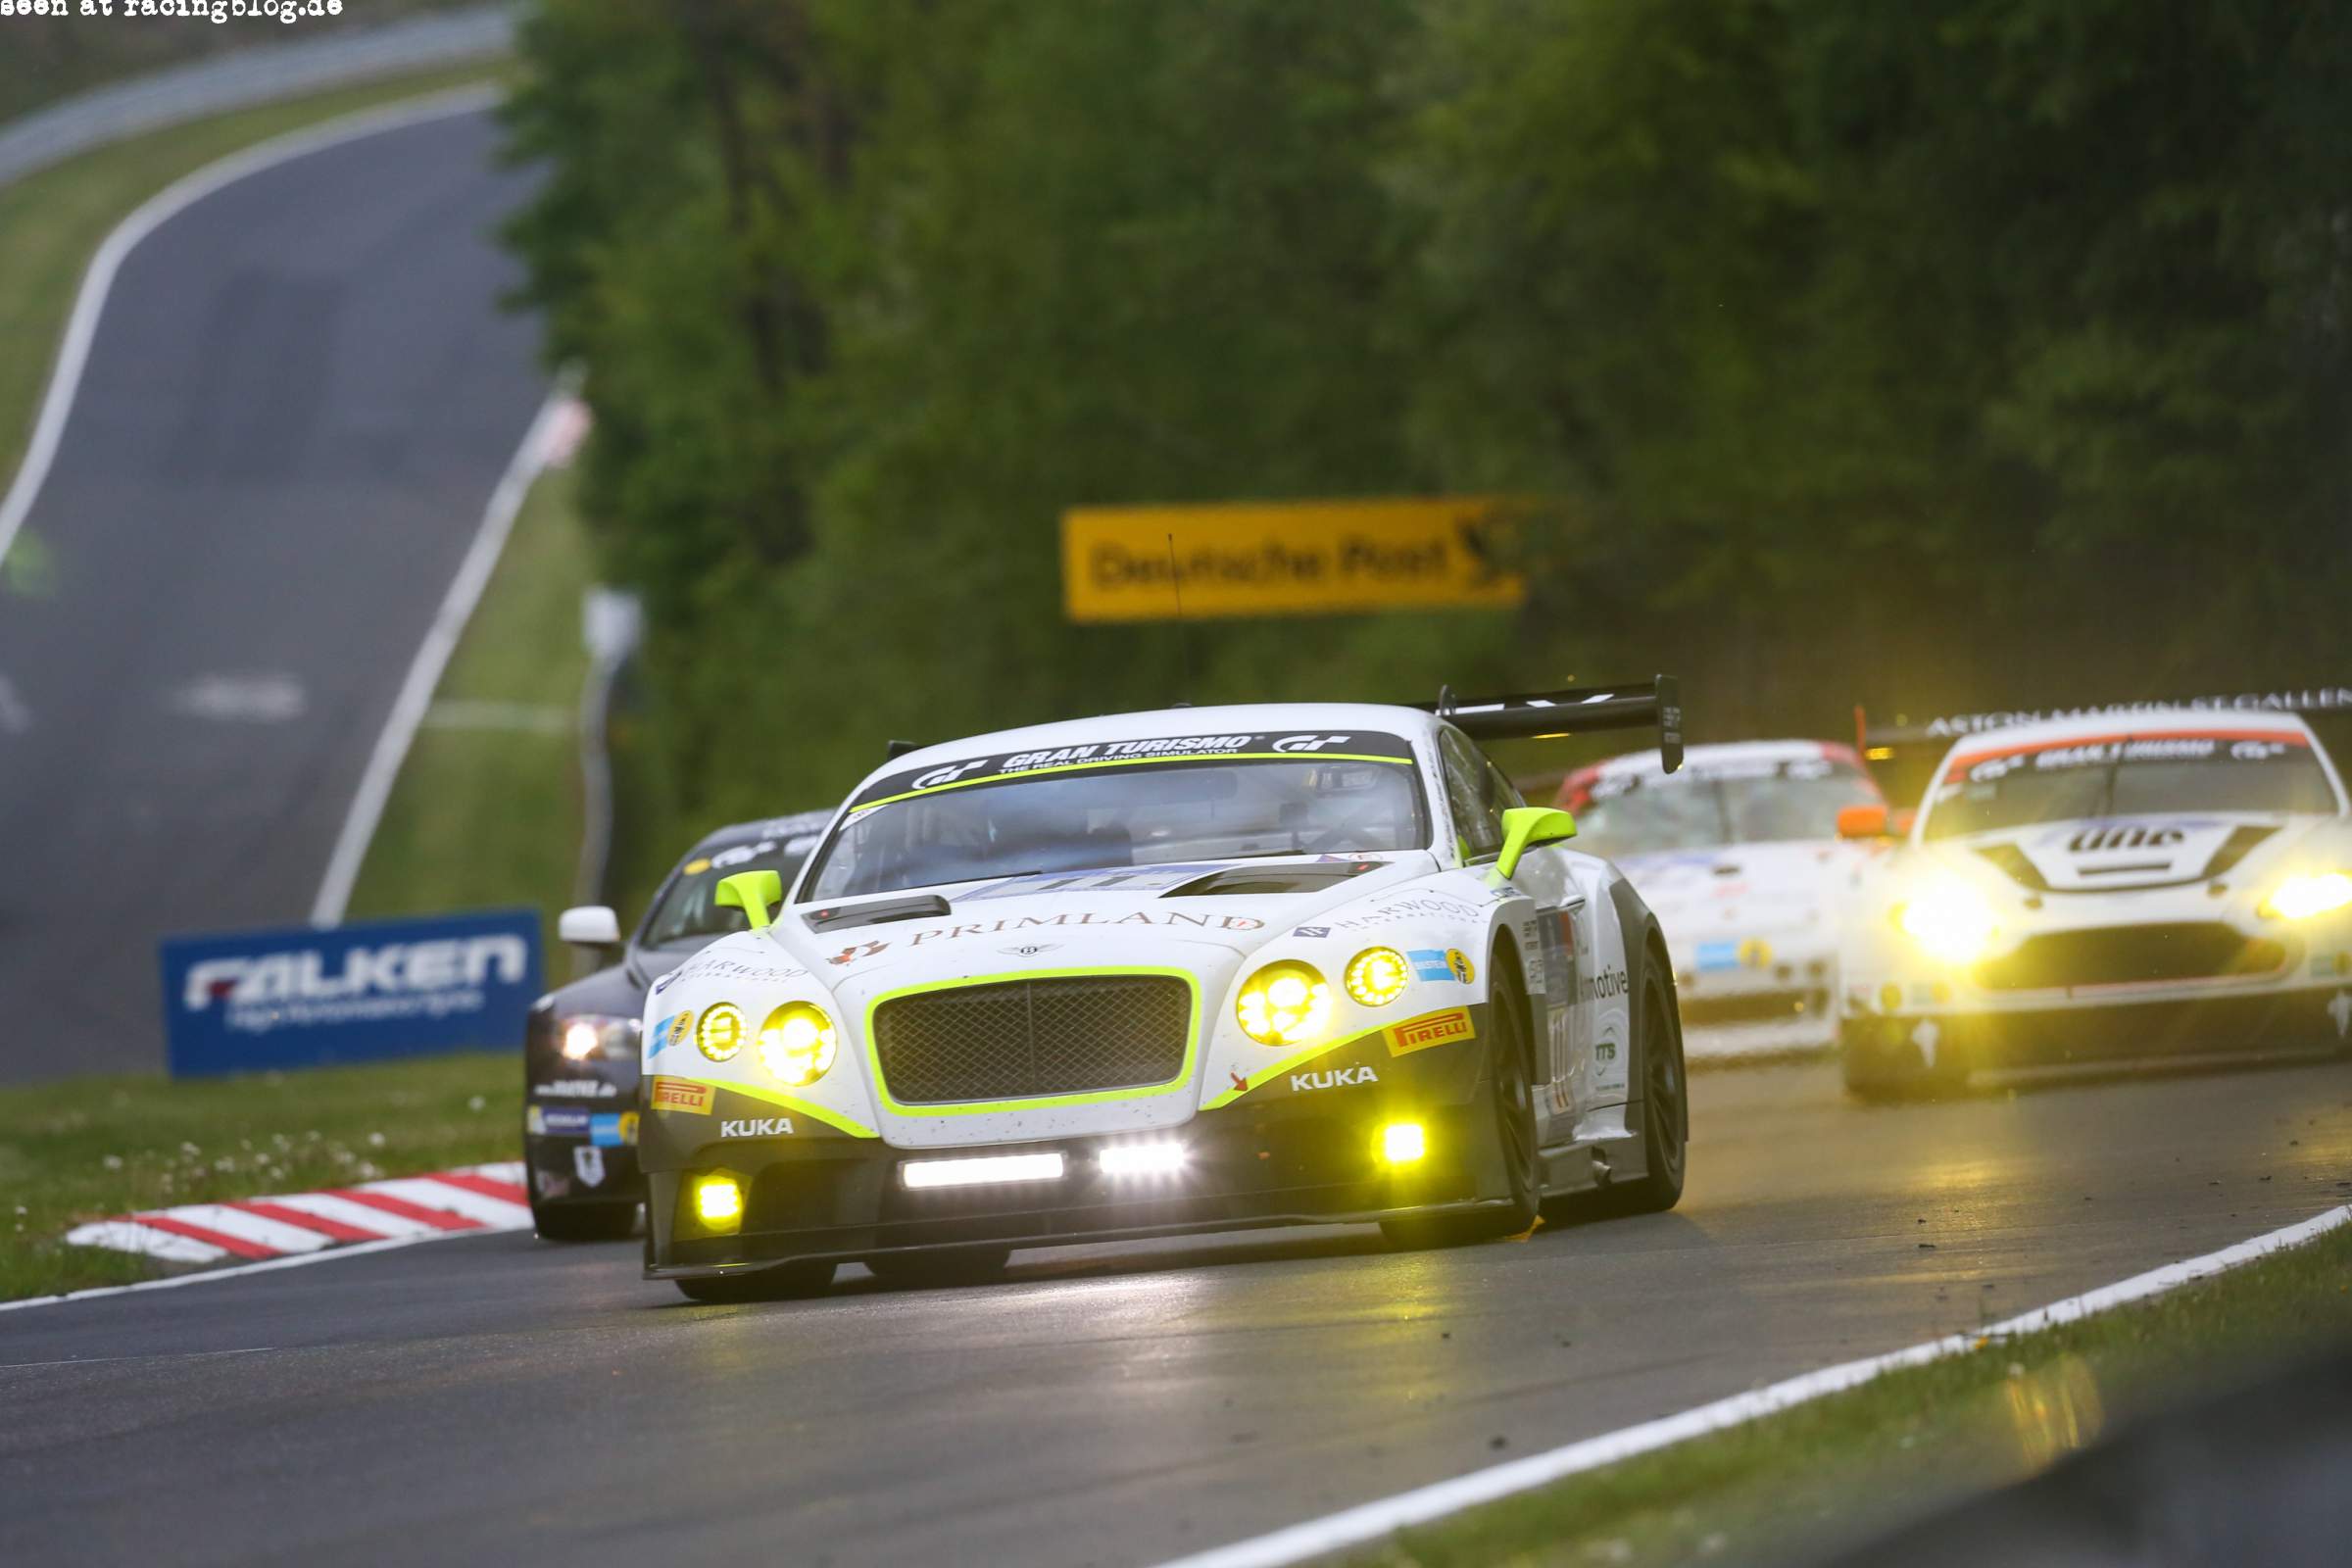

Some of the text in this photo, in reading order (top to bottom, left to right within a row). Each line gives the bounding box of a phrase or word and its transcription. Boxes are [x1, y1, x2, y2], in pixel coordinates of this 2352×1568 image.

[998, 748, 1238, 774] THE REAL DRIVING SIMULATOR
[1003, 735, 1252, 769] GRAN TURISMO
[907, 910, 1267, 948] PRIMLAND
[1335, 900, 1480, 929] HARWOOD
[1393, 1011, 1468, 1048] PIRELLI
[1291, 1065, 1379, 1092] KUKA
[721, 1117, 794, 1138] KUKA
